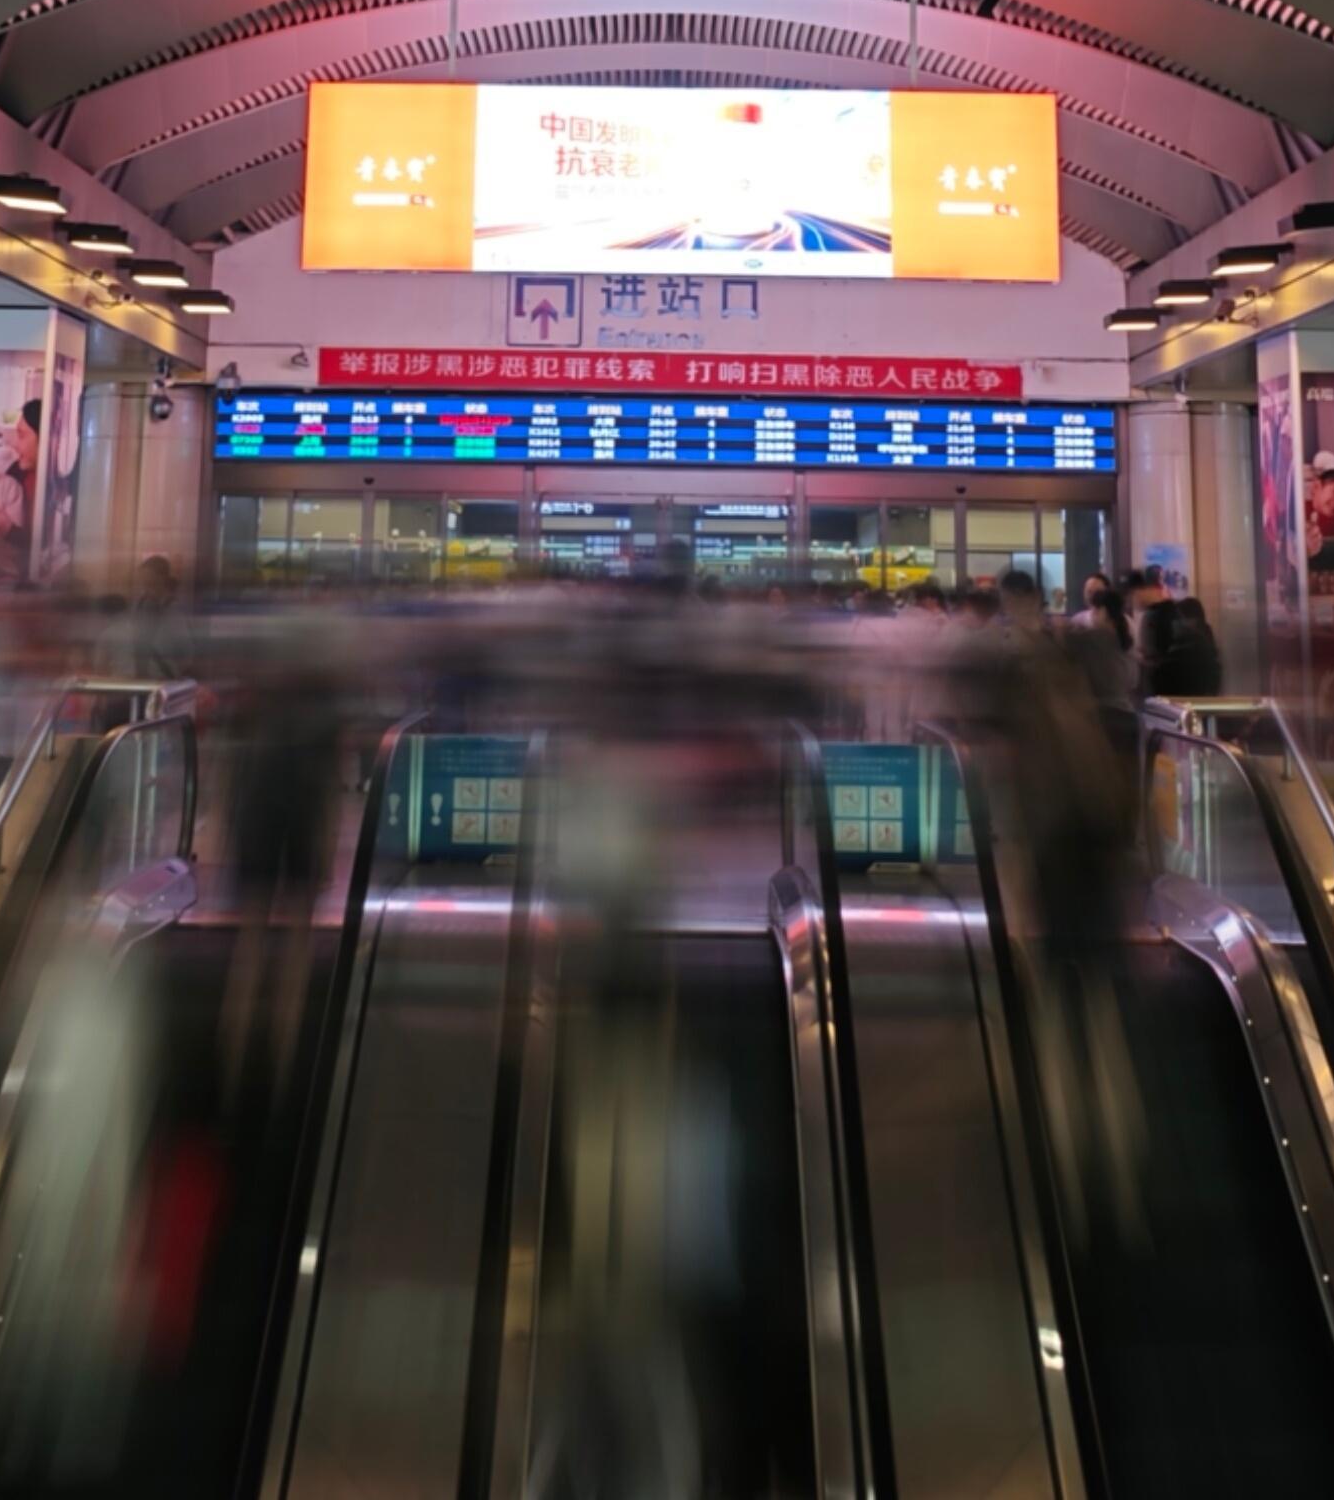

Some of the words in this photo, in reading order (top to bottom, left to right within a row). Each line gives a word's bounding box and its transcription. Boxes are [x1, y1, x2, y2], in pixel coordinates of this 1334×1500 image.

[600, 275, 760, 320] 进站口
[339, 352, 655, 381] 举报涉黑涉恶犯罪线索
[685, 359, 1002, 391] 打响扫黑除恶人民战争
